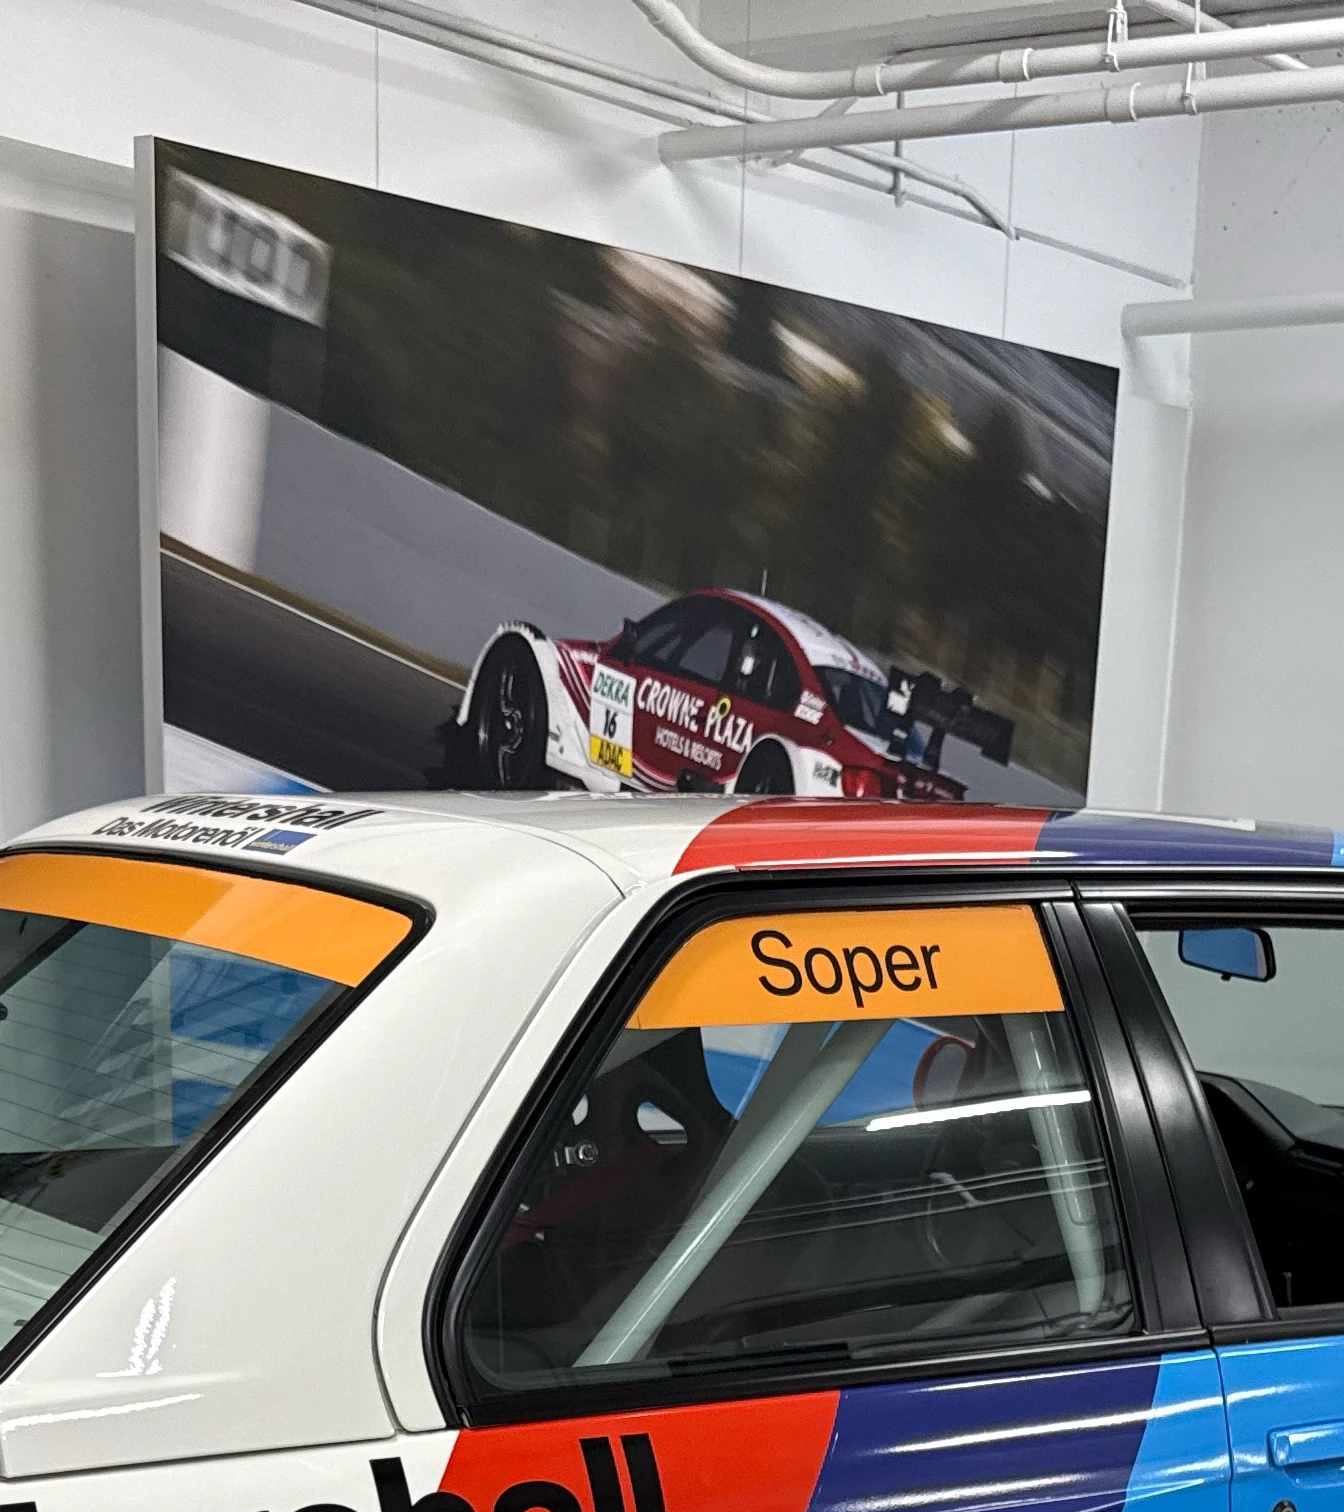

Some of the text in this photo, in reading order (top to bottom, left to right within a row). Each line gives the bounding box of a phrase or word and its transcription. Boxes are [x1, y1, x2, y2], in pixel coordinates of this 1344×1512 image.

[593, 671, 631, 707] DEKRA
[605, 709, 618, 739] 16
[637, 677, 704, 733] CROWNE
[704, 704, 755, 753] PLAZA
[598, 741, 623, 772] ADAC
[654, 726, 685, 755] HOTELS
[690, 741, 723, 771] RESORTS
[140, 795, 386, 830] Wintershall
[91, 817, 144, 837] Das
[132, 818, 266, 848] Motorenöl
[750, 929, 941, 1009] Soper
